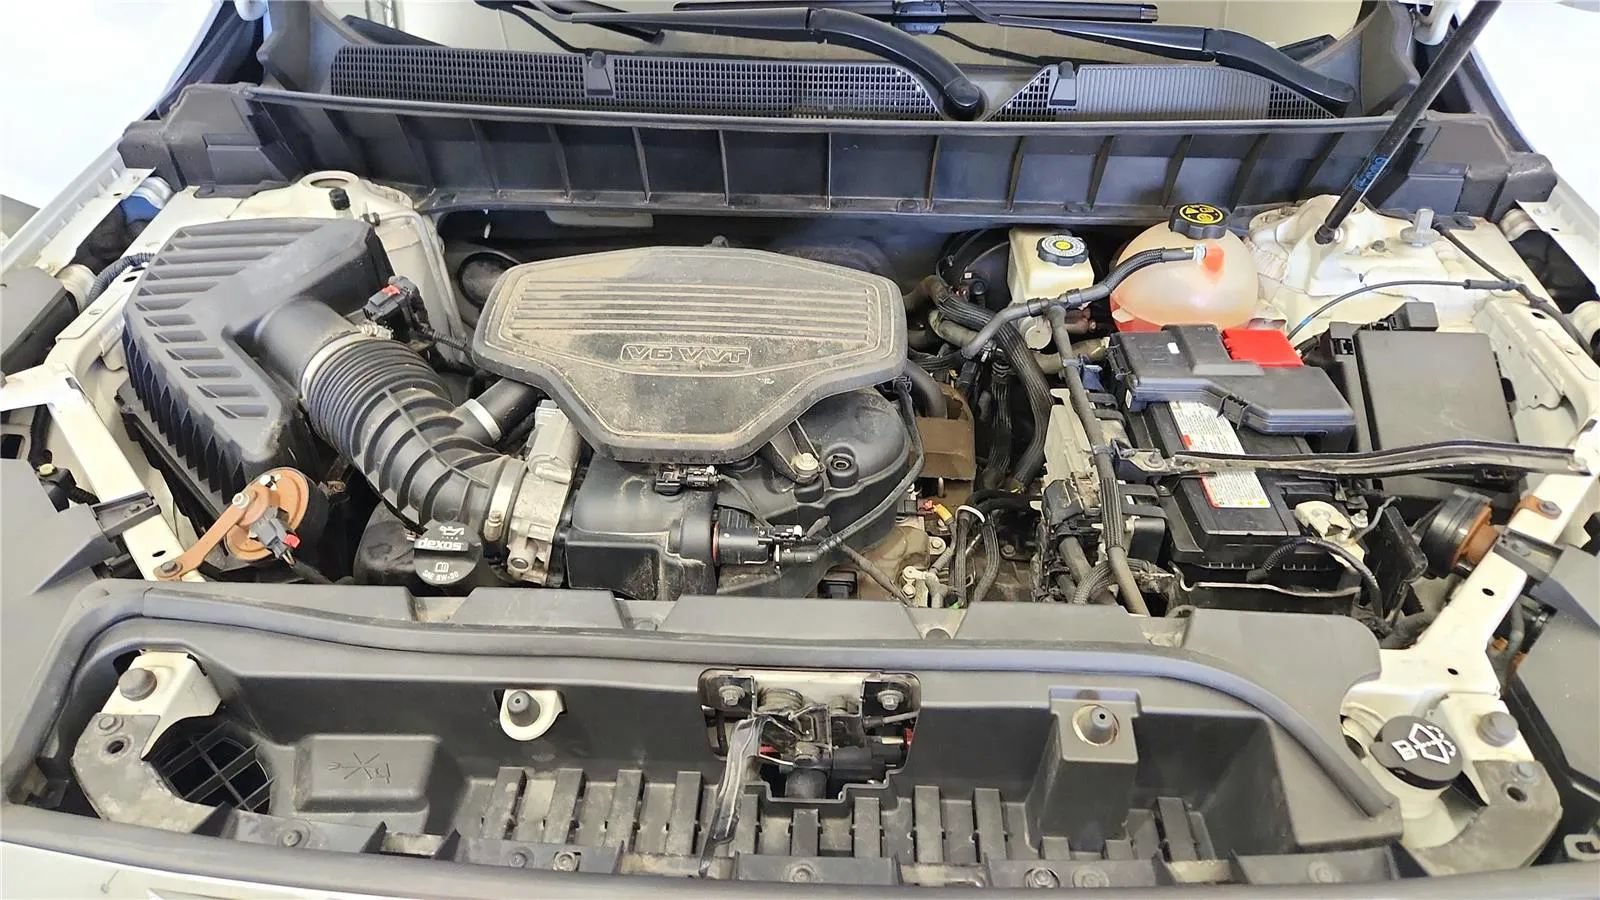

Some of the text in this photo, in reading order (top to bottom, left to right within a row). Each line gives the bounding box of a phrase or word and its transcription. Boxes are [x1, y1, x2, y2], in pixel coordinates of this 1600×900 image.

[626, 344, 748, 363] V6 VVT
[418, 537, 464, 551] dexos
